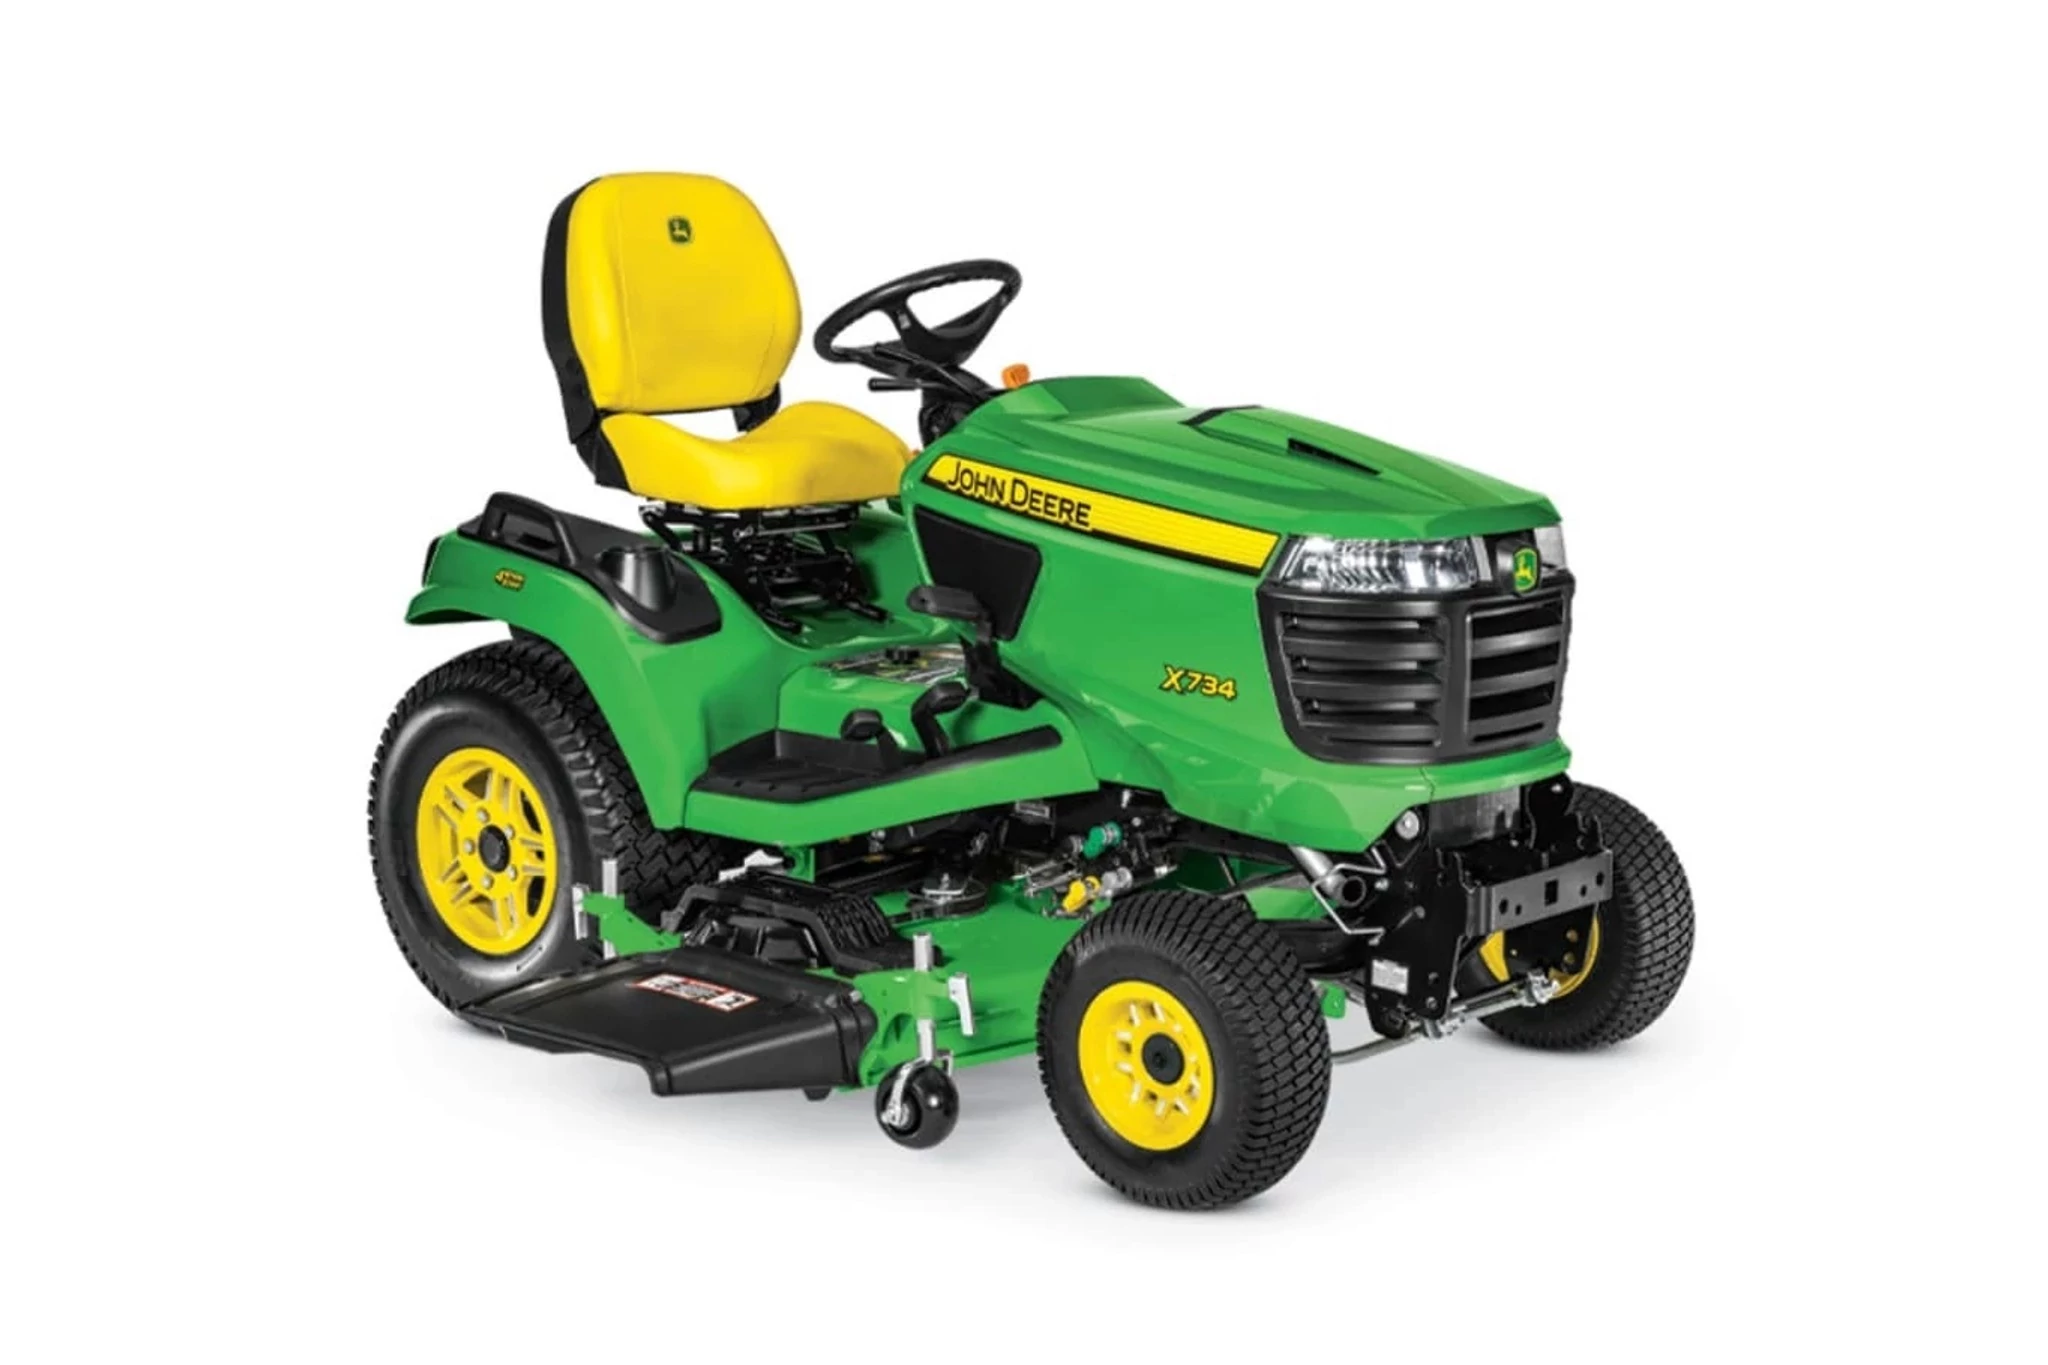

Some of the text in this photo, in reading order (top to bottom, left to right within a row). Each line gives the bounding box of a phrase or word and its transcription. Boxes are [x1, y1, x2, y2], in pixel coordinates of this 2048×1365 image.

[948, 461, 1092, 528] JOHN DEERE
[1161, 664, 1237, 700] X734
